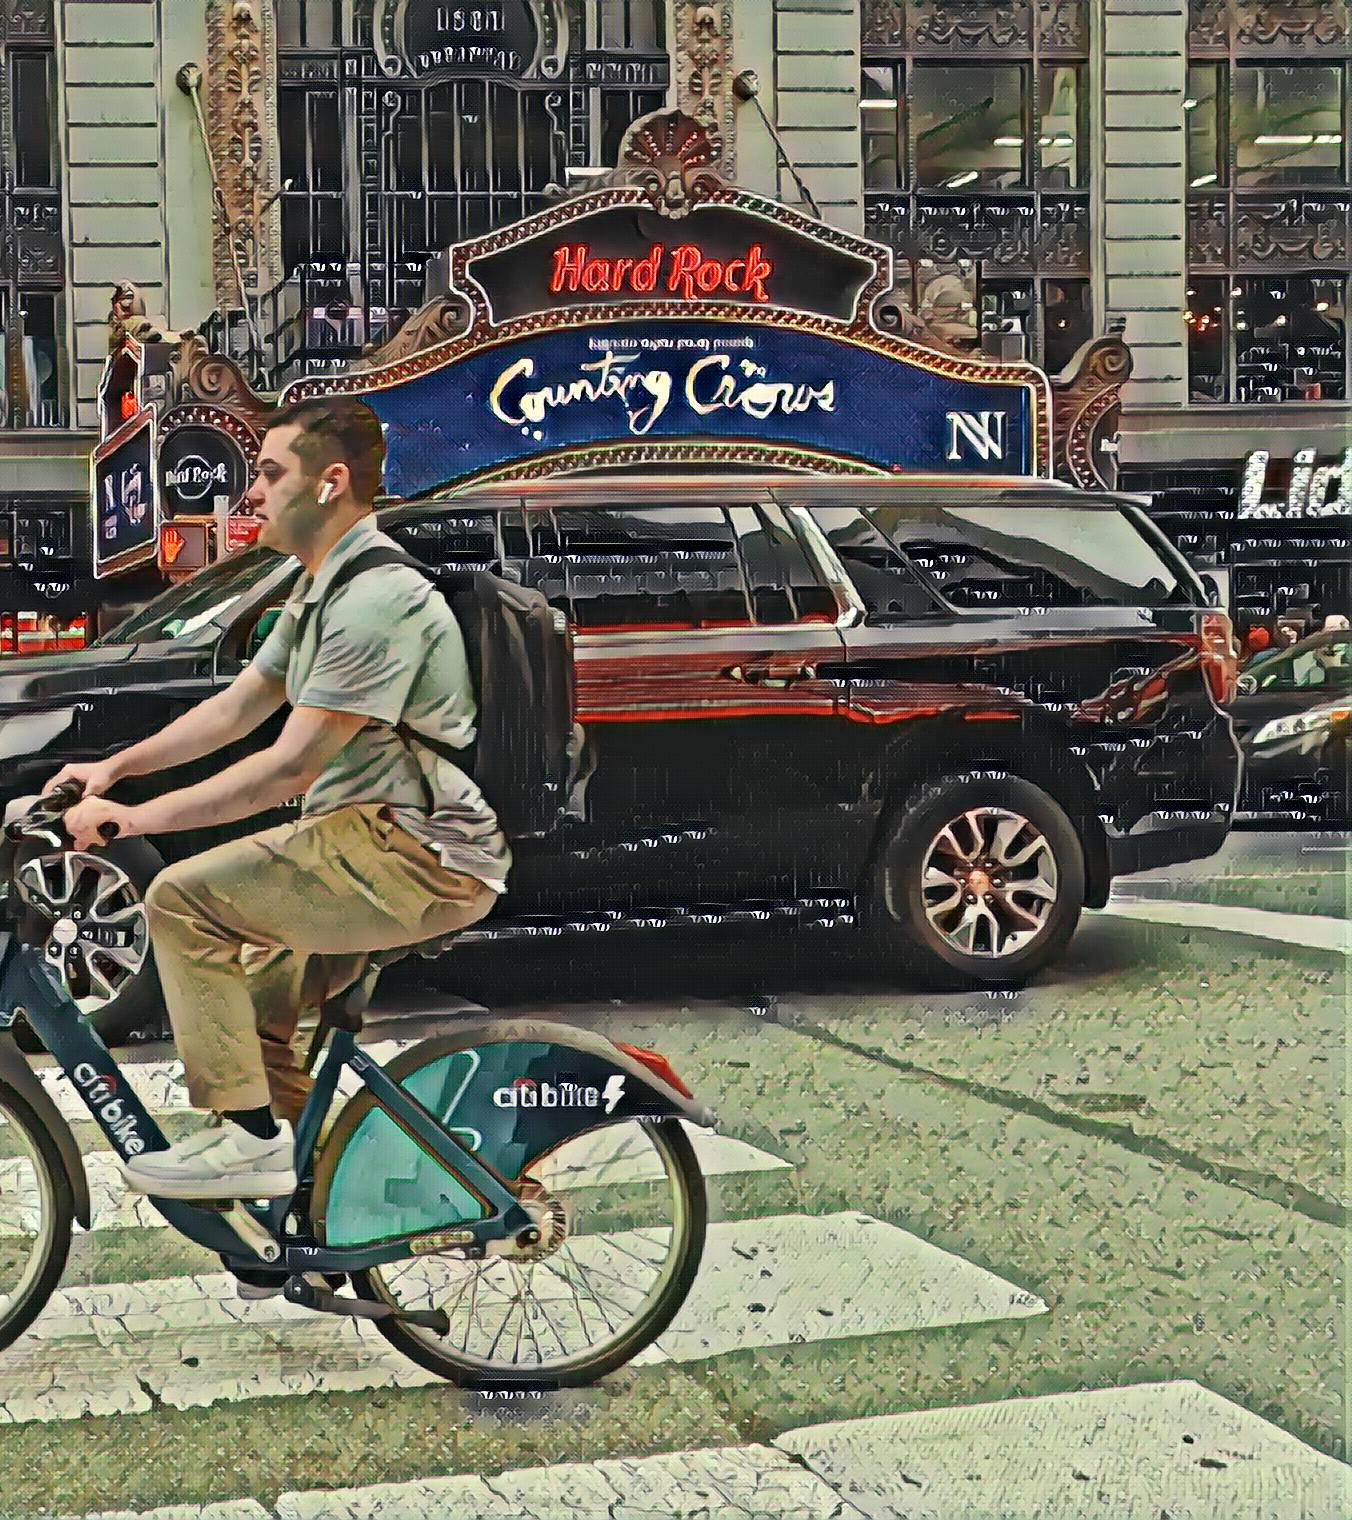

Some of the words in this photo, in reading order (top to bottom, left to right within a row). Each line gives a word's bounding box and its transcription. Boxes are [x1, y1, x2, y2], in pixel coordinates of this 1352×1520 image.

[551, 244, 663, 294] Hard
[667, 244, 772, 302] Rock
[490, 350, 672, 439] Counting
[686, 354, 835, 419] Crows
[73, 1062, 145, 1155] citibike
